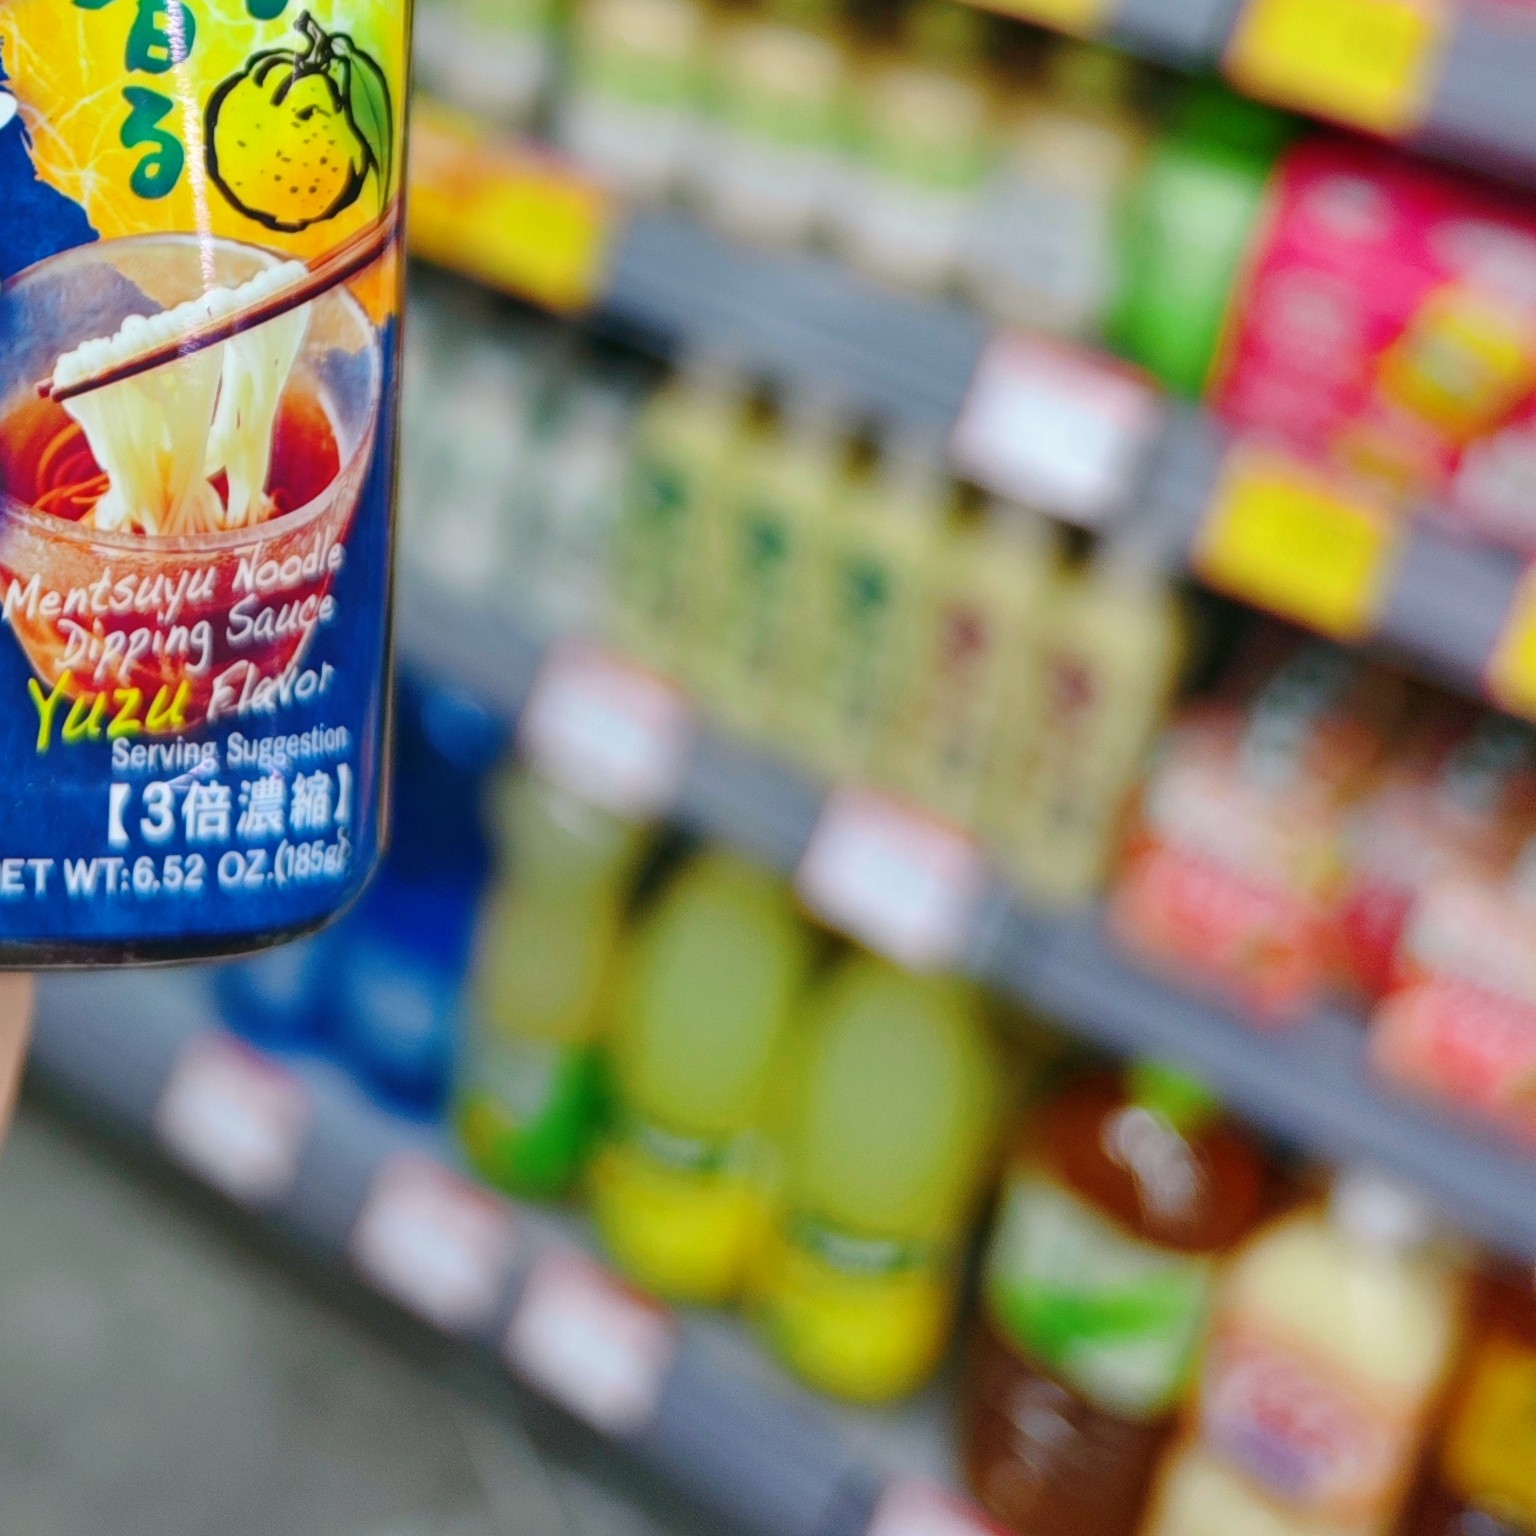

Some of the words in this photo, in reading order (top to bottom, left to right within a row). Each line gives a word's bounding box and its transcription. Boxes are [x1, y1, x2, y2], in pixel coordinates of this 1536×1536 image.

[1, 566, 218, 625] Mentsuyu
[231, 525, 346, 592] Noodle
[56, 617, 214, 686] Dipping
[225, 593, 337, 643] Sauce
[28, 668, 192, 753] Yuzu
[206, 659, 336, 723] Flavor
[111, 735, 218, 770] Serving
[226, 723, 349, 768] Suggestion
